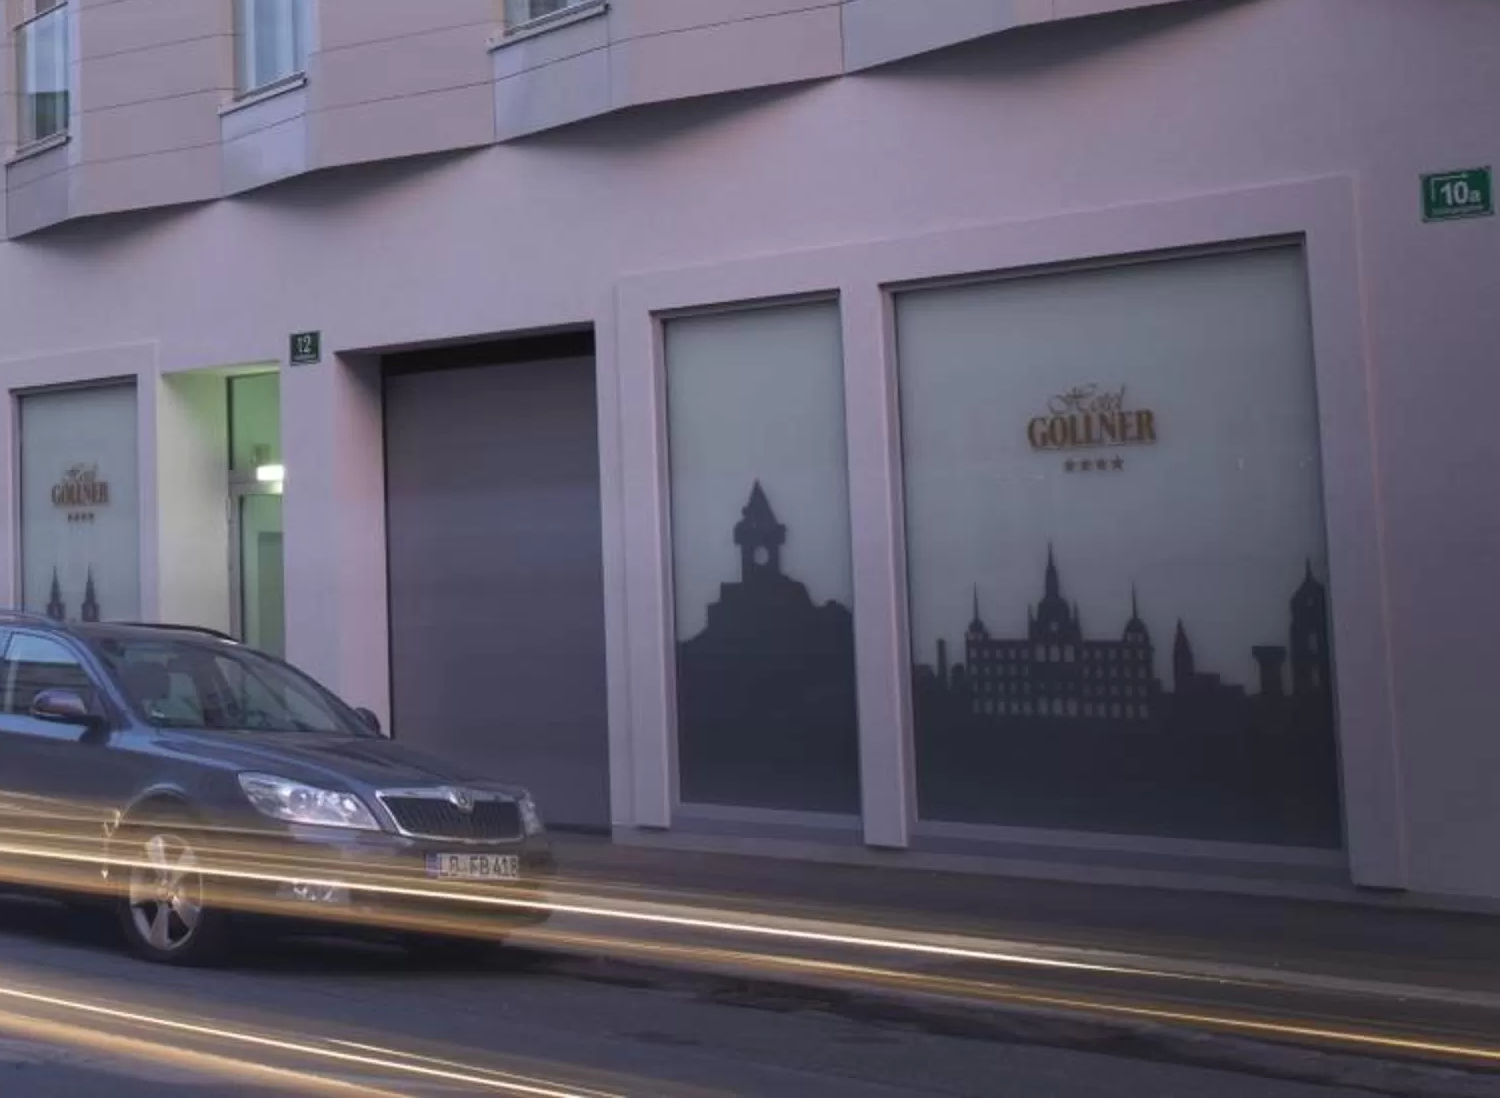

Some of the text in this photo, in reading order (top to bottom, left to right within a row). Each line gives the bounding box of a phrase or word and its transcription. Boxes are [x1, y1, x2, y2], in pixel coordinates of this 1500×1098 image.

[1440, 181, 1481, 206] 10a
[297, 335, 311, 353] 12
[1028, 409, 1156, 450] GOLLNER
